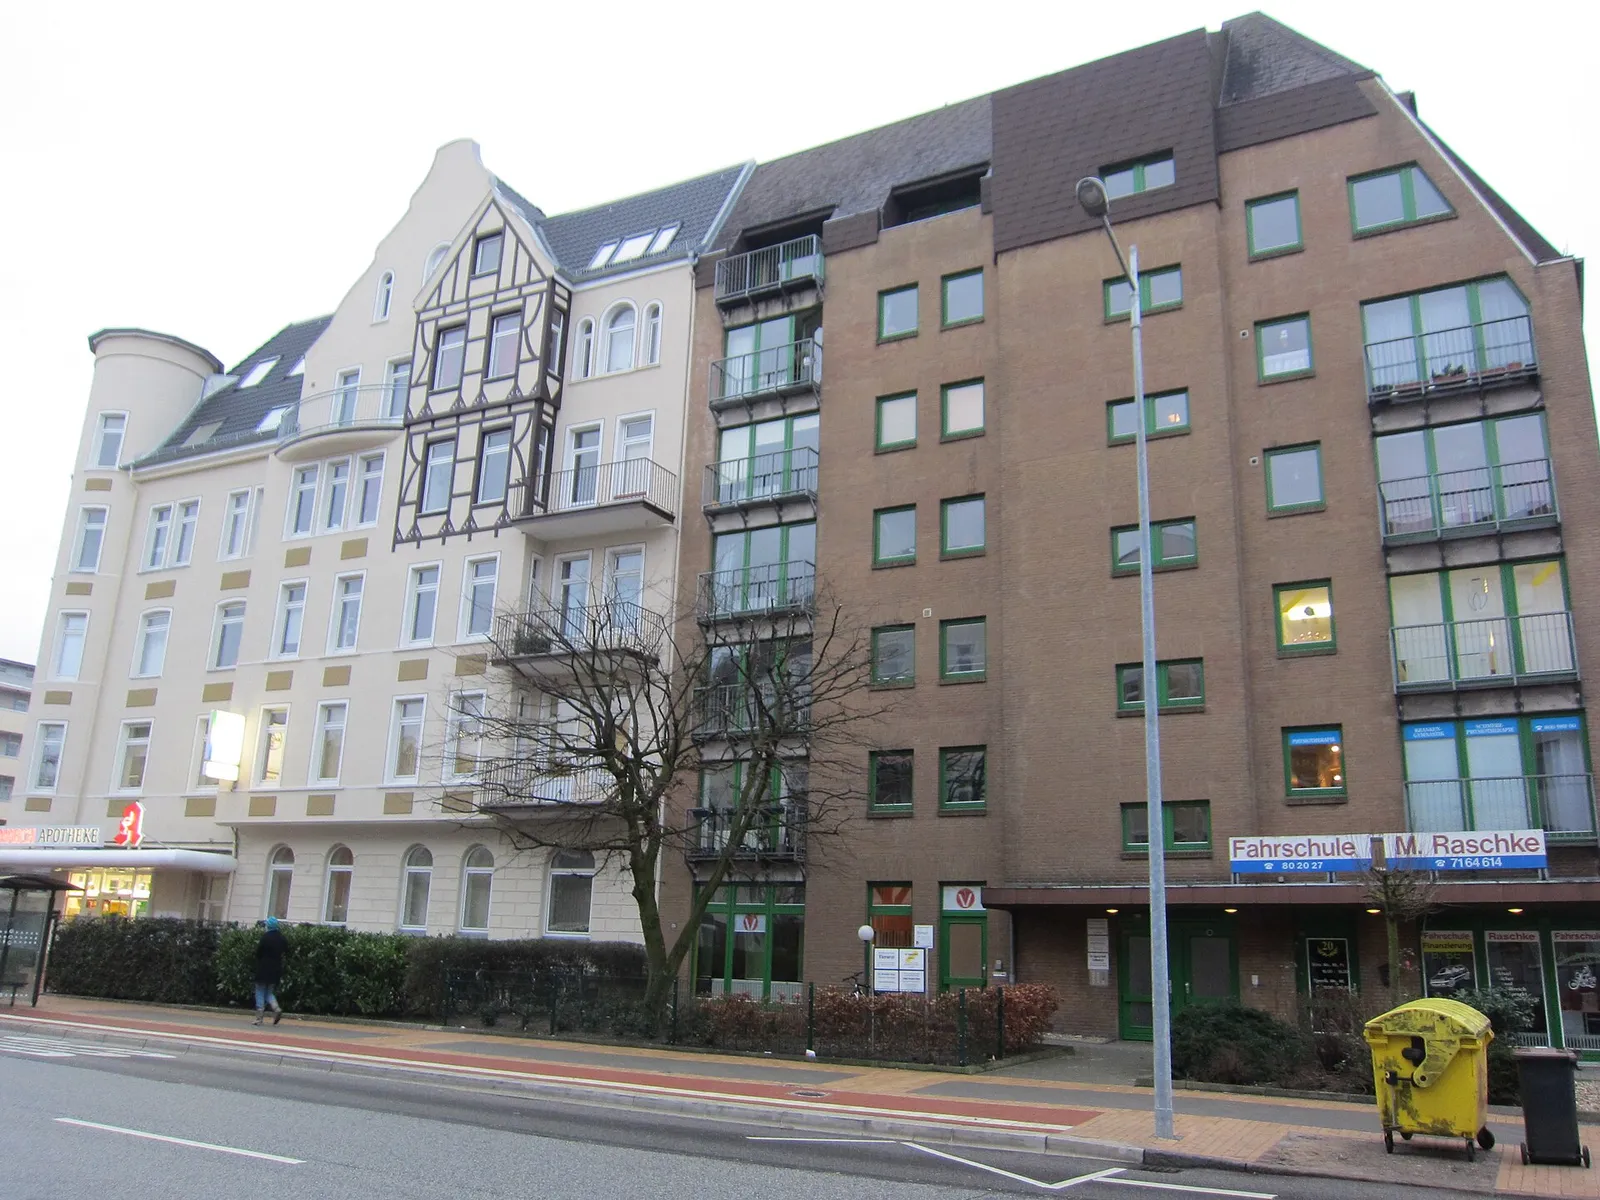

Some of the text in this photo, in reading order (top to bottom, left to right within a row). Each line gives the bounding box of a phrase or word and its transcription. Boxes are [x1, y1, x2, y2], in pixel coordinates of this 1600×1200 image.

[38, 827, 100, 843] APOTHEKE
[1233, 837, 1356, 858] Fahrschule
[1395, 833, 1540, 855] M. Raschke
[1424, 932, 1471, 940] Fahrschule
[1488, 932, 1536, 941] Raschke
[1422, 942, 1473, 950] Finanzierung
